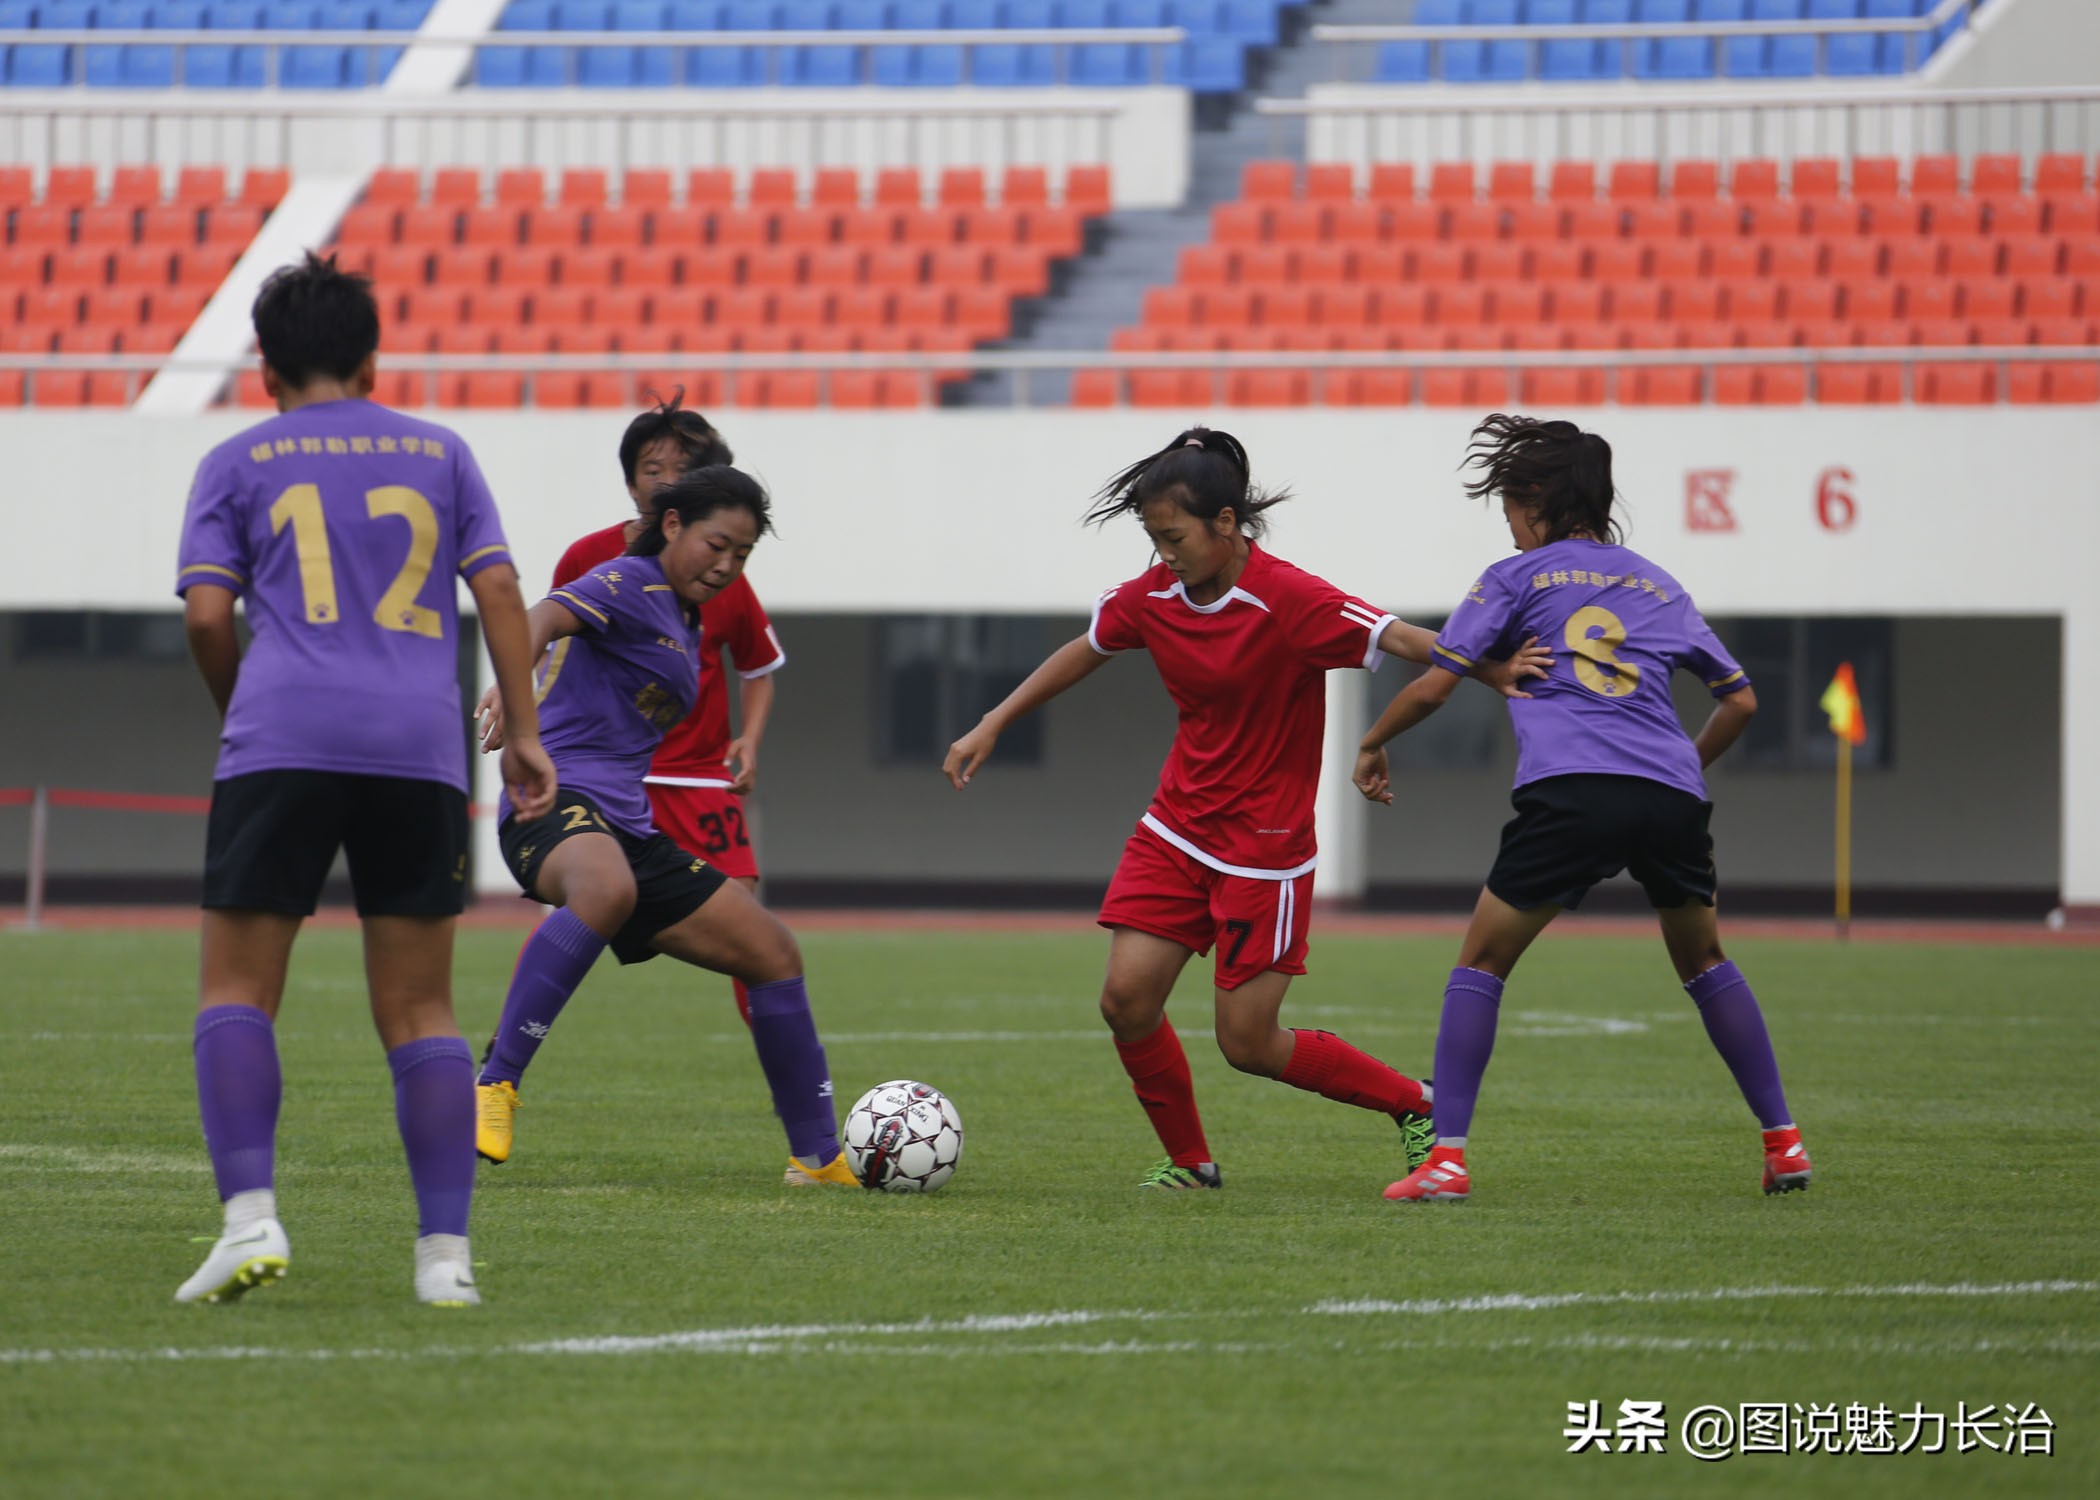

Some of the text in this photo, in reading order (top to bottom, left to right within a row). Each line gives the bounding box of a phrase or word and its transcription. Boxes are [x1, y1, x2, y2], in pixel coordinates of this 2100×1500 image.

[1813, 464, 1857, 532] 6
[269, 483, 443, 639] 12
[698, 806, 749, 856] 32
[1225, 918, 1253, 969] 7
